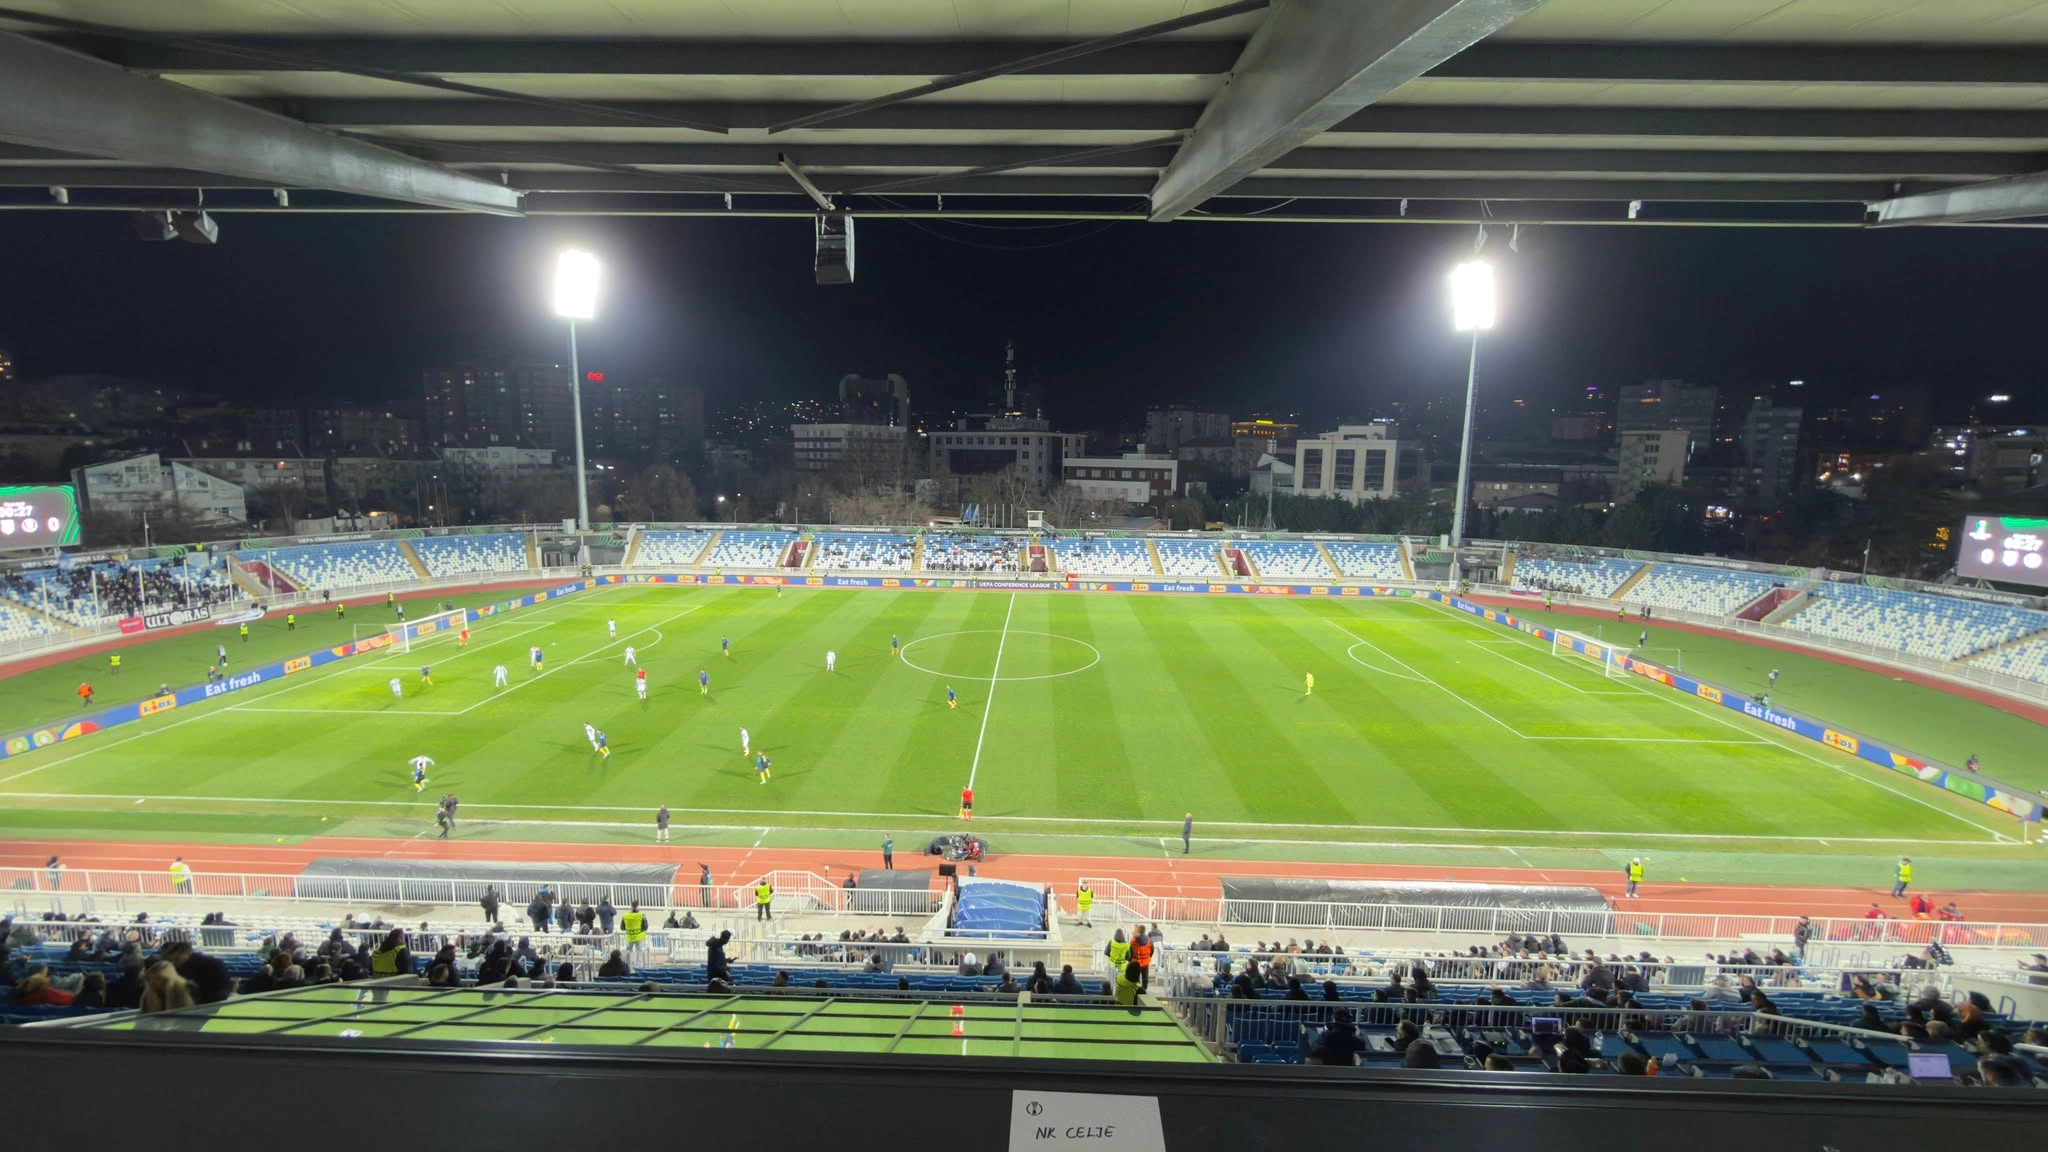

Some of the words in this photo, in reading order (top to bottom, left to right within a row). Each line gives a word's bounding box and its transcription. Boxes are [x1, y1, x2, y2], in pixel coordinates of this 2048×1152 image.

[205, 681, 227, 697] Eat
[228, 672, 261, 689] fresh
[1744, 701, 1762, 717] Eat
[1765, 709, 1796, 730] fresh
[1036, 1126, 1057, 1140] NK
[1066, 1125, 1116, 1139] CELJE
